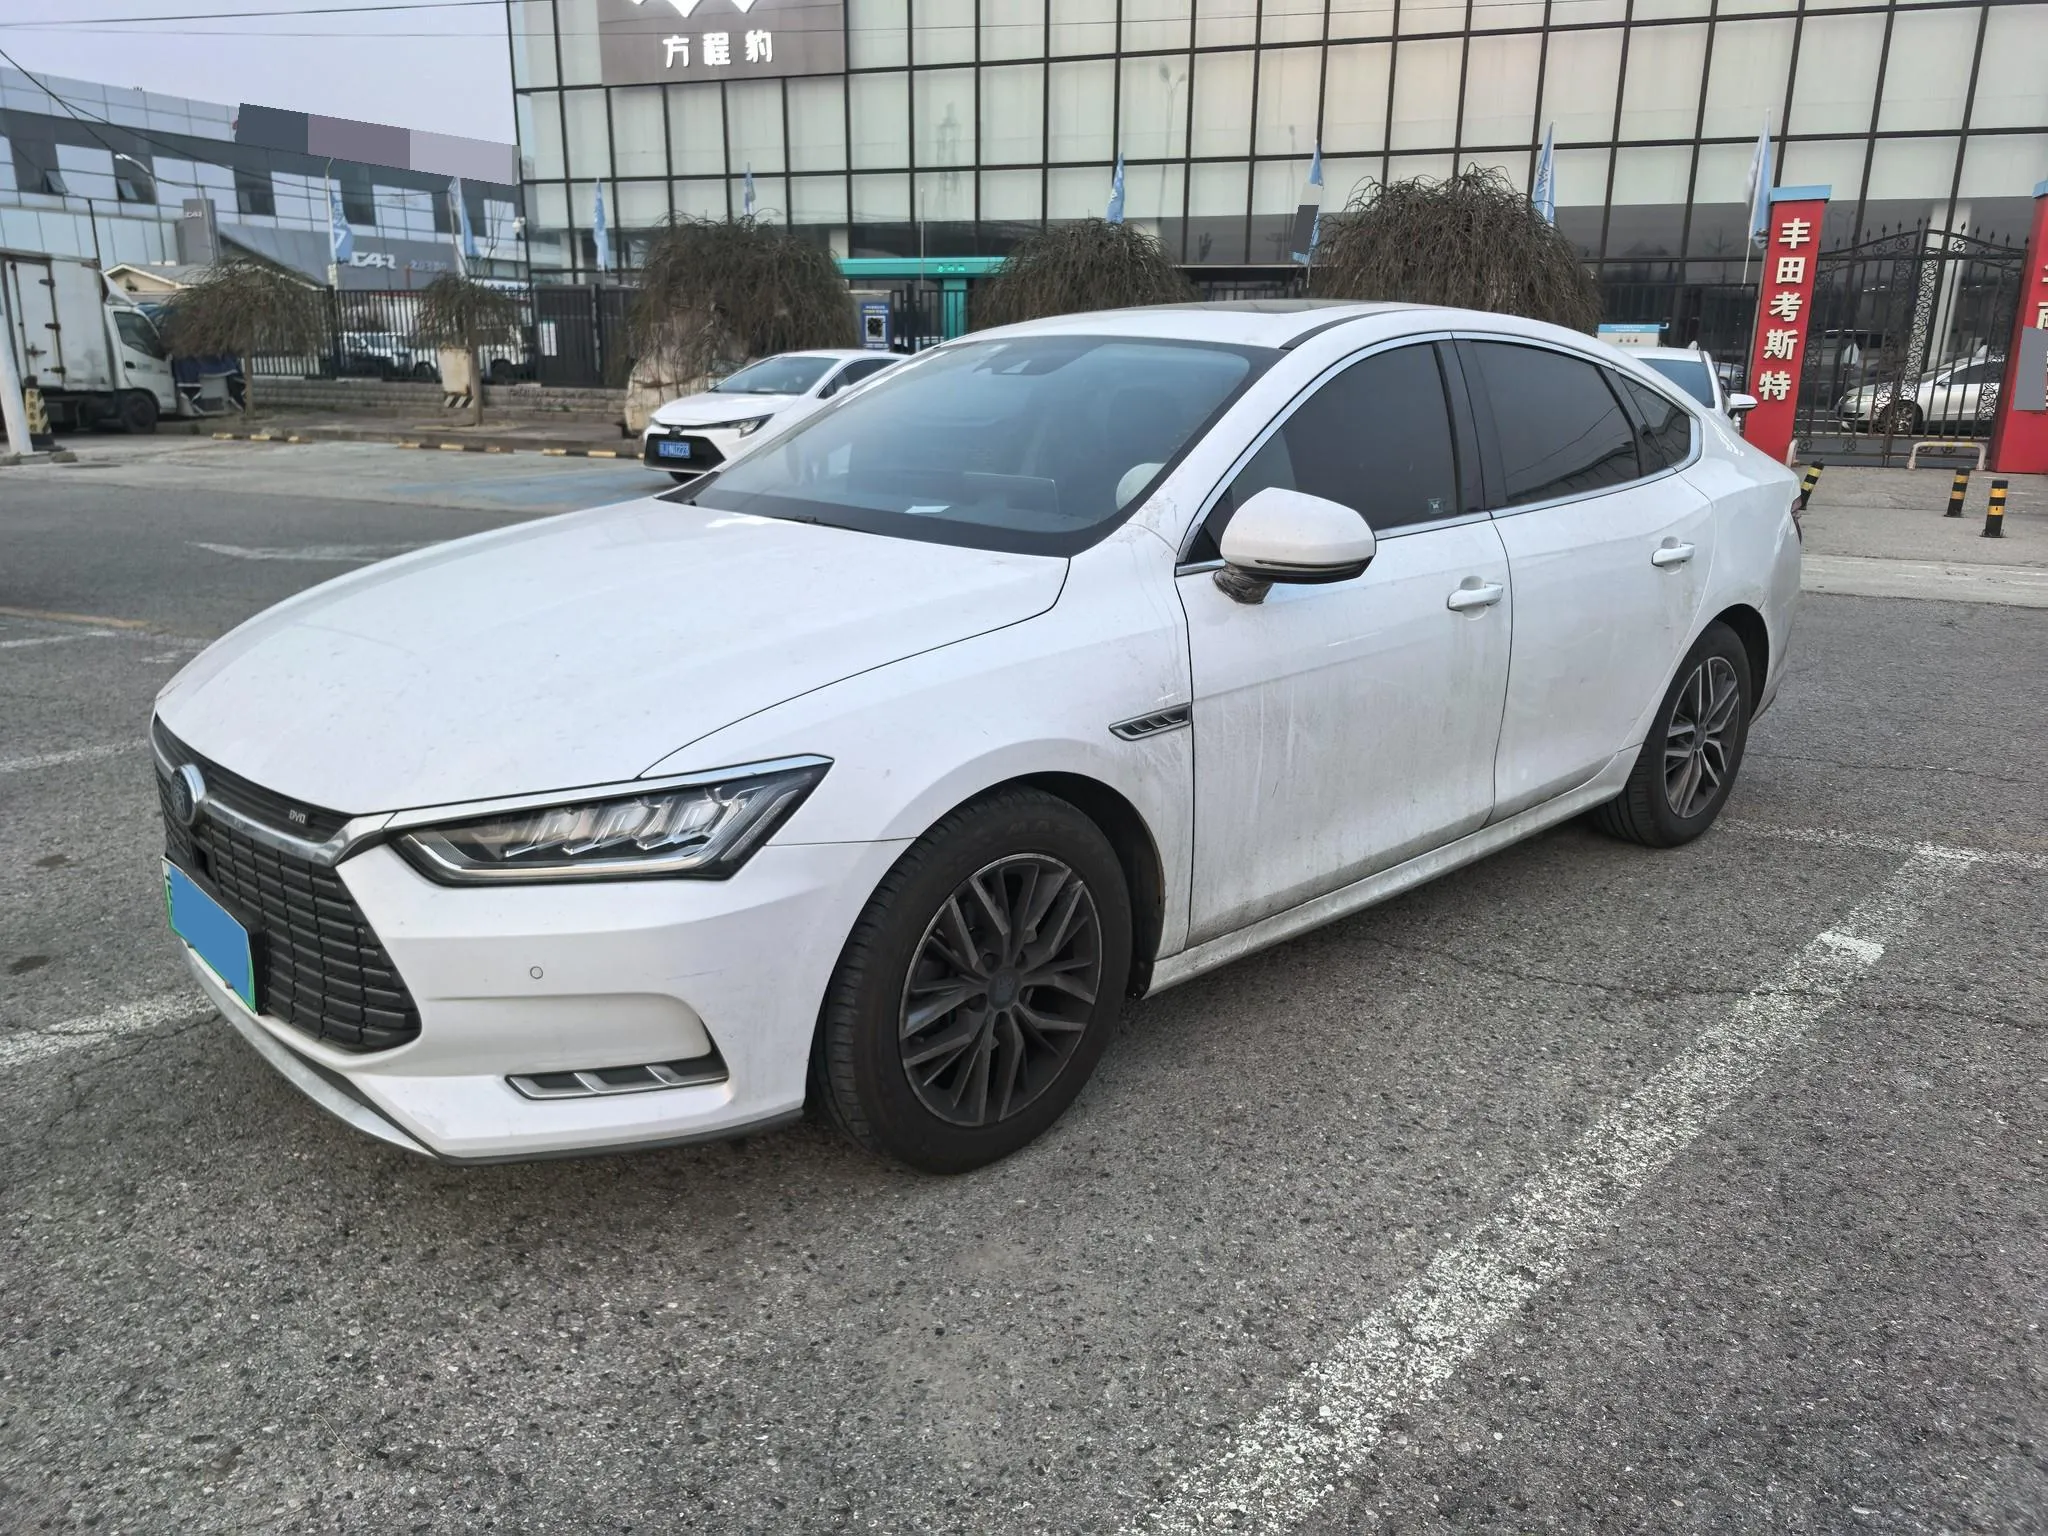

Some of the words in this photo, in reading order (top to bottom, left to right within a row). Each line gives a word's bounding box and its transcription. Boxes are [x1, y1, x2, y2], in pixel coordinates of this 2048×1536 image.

[662, 29, 773, 68] 方程豹
[1758, 217, 1811, 401] 丰田考斯特
